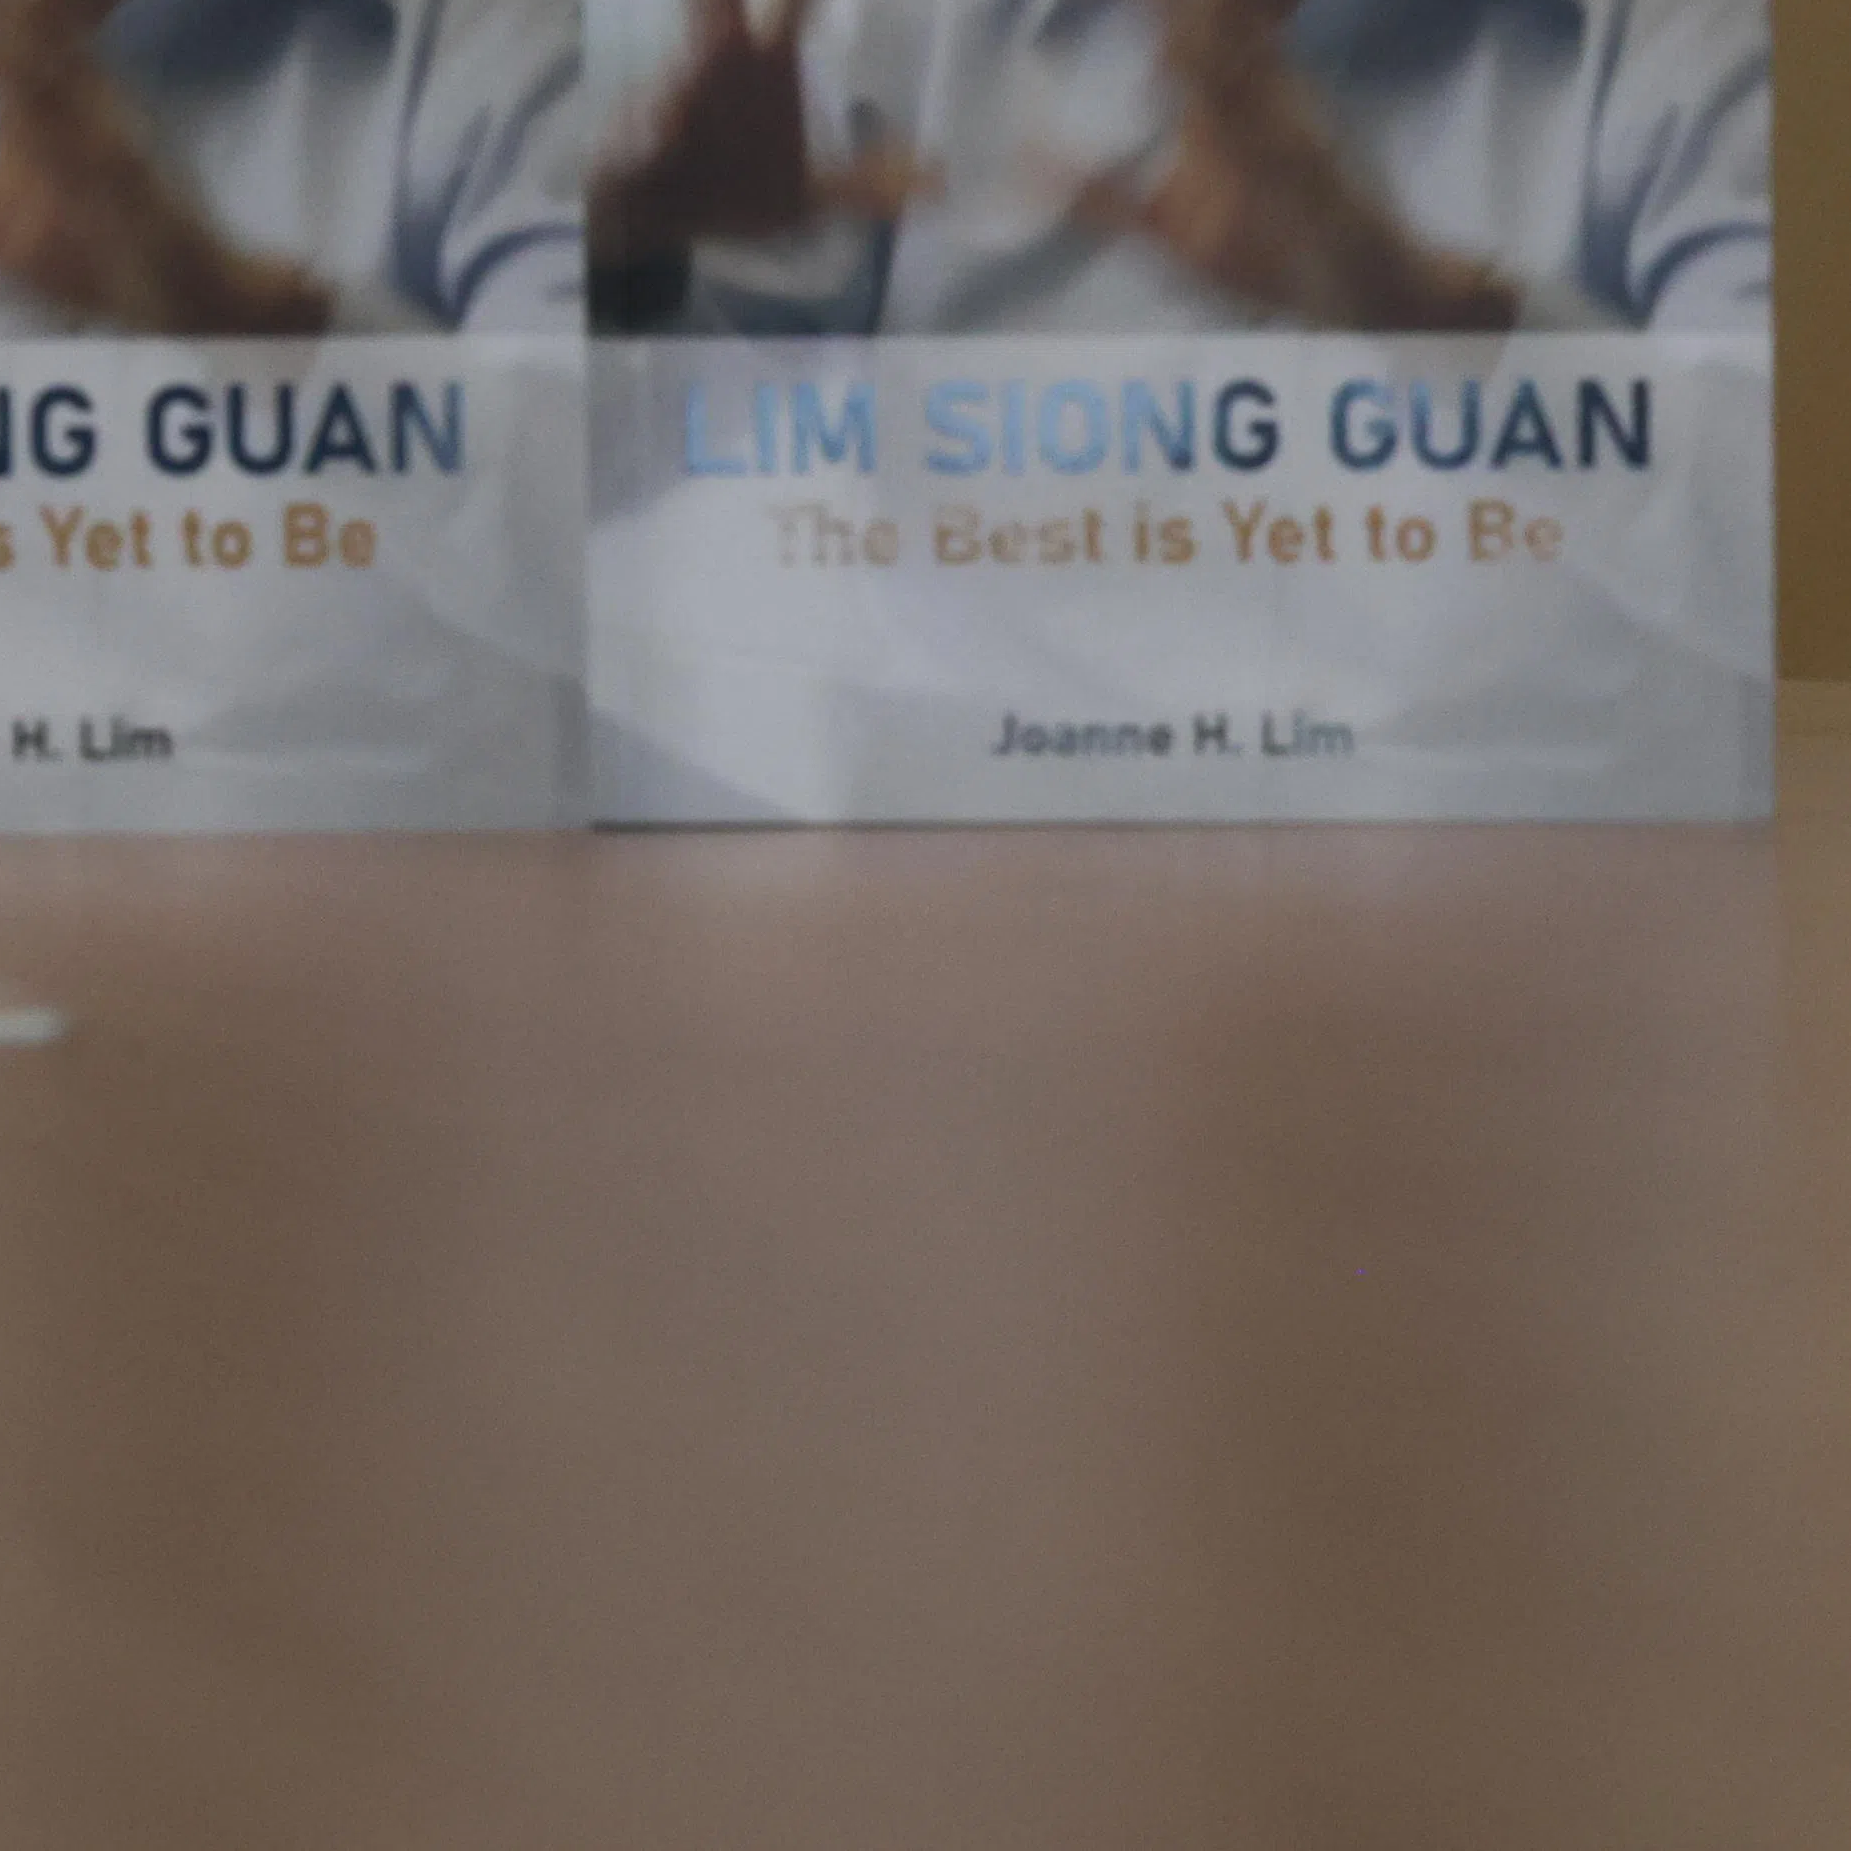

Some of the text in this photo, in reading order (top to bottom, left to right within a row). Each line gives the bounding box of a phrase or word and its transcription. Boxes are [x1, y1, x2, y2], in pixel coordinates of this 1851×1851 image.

[146, 382, 462, 478] GUAN
[683, 379, 1651, 476] LIM SIONG GUAN
[39, 506, 151, 568] Yet
[183, 510, 251, 568] to
[283, 504, 377, 568] Be
[769, 500, 1564, 567] The Best is Yet to Be
[13, 721, 62, 761] H.
[80, 719, 173, 760] Lim
[991, 713, 1354, 756] Joanne H. Lim
